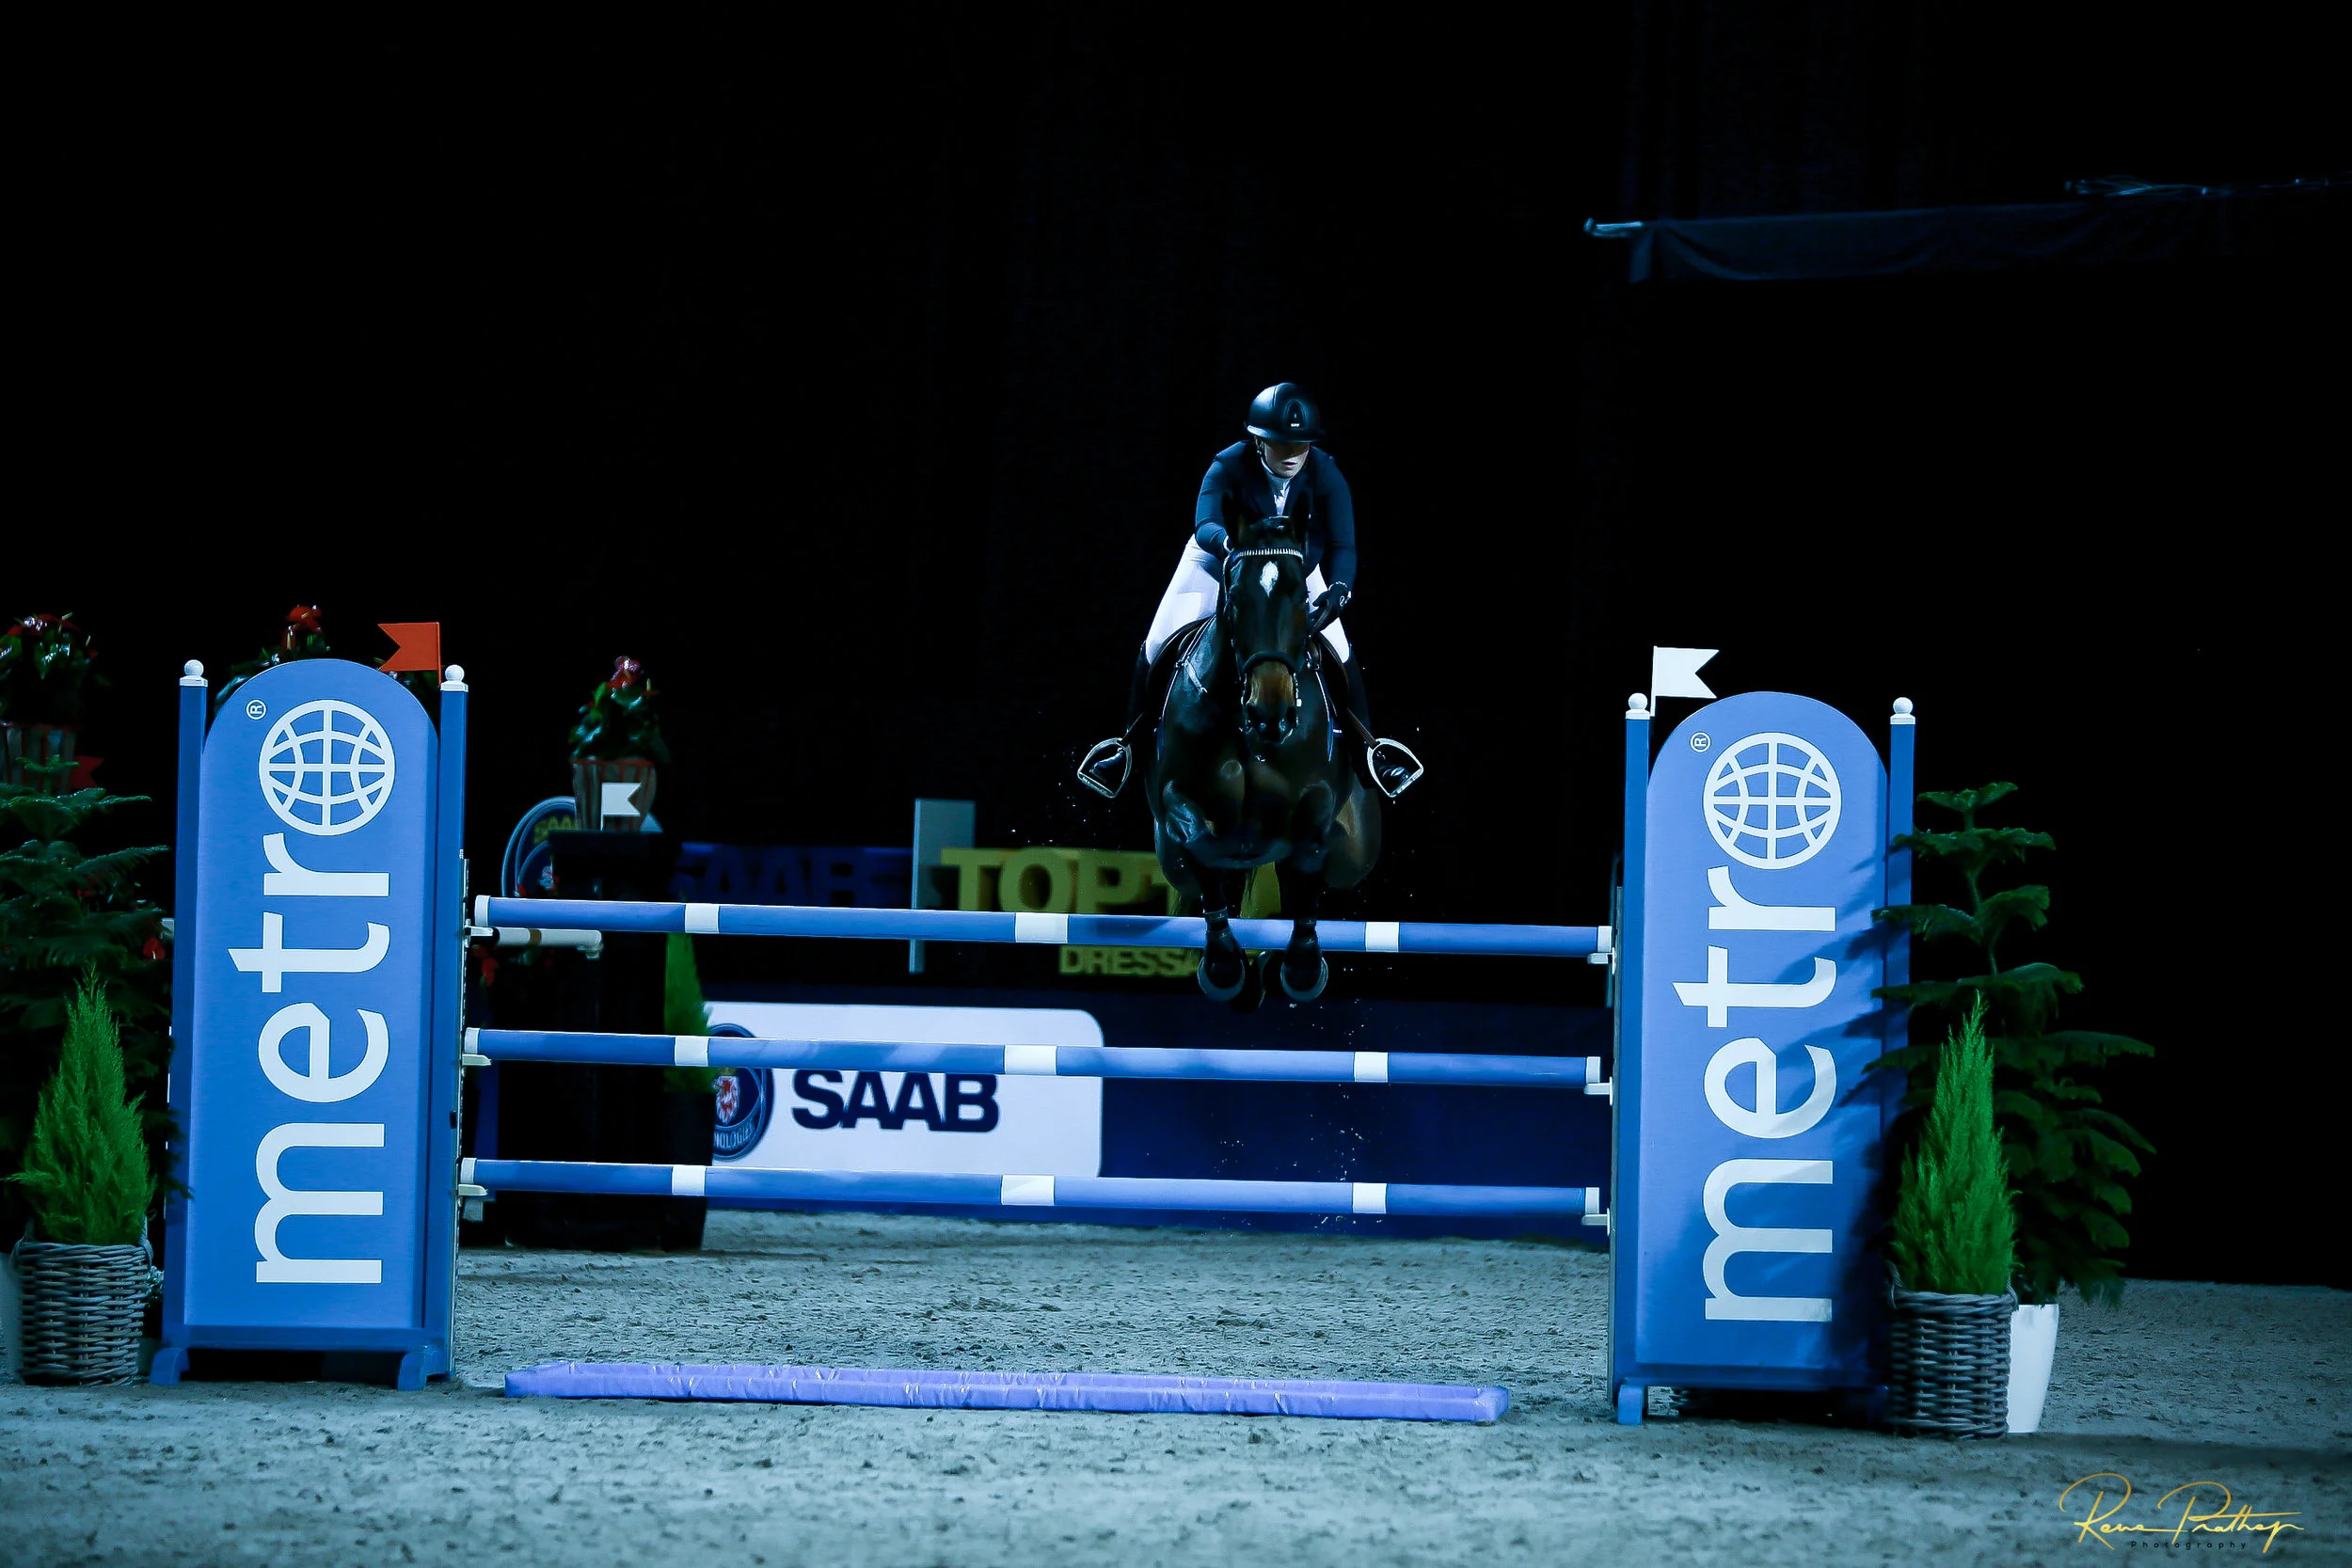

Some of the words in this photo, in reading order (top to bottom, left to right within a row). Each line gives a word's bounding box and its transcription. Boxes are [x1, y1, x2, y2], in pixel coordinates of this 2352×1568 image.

[228, 699, 396, 1284] metro
[791, 1067, 1000, 1132] SAAB
[1672, 731, 1842, 1323] metro
